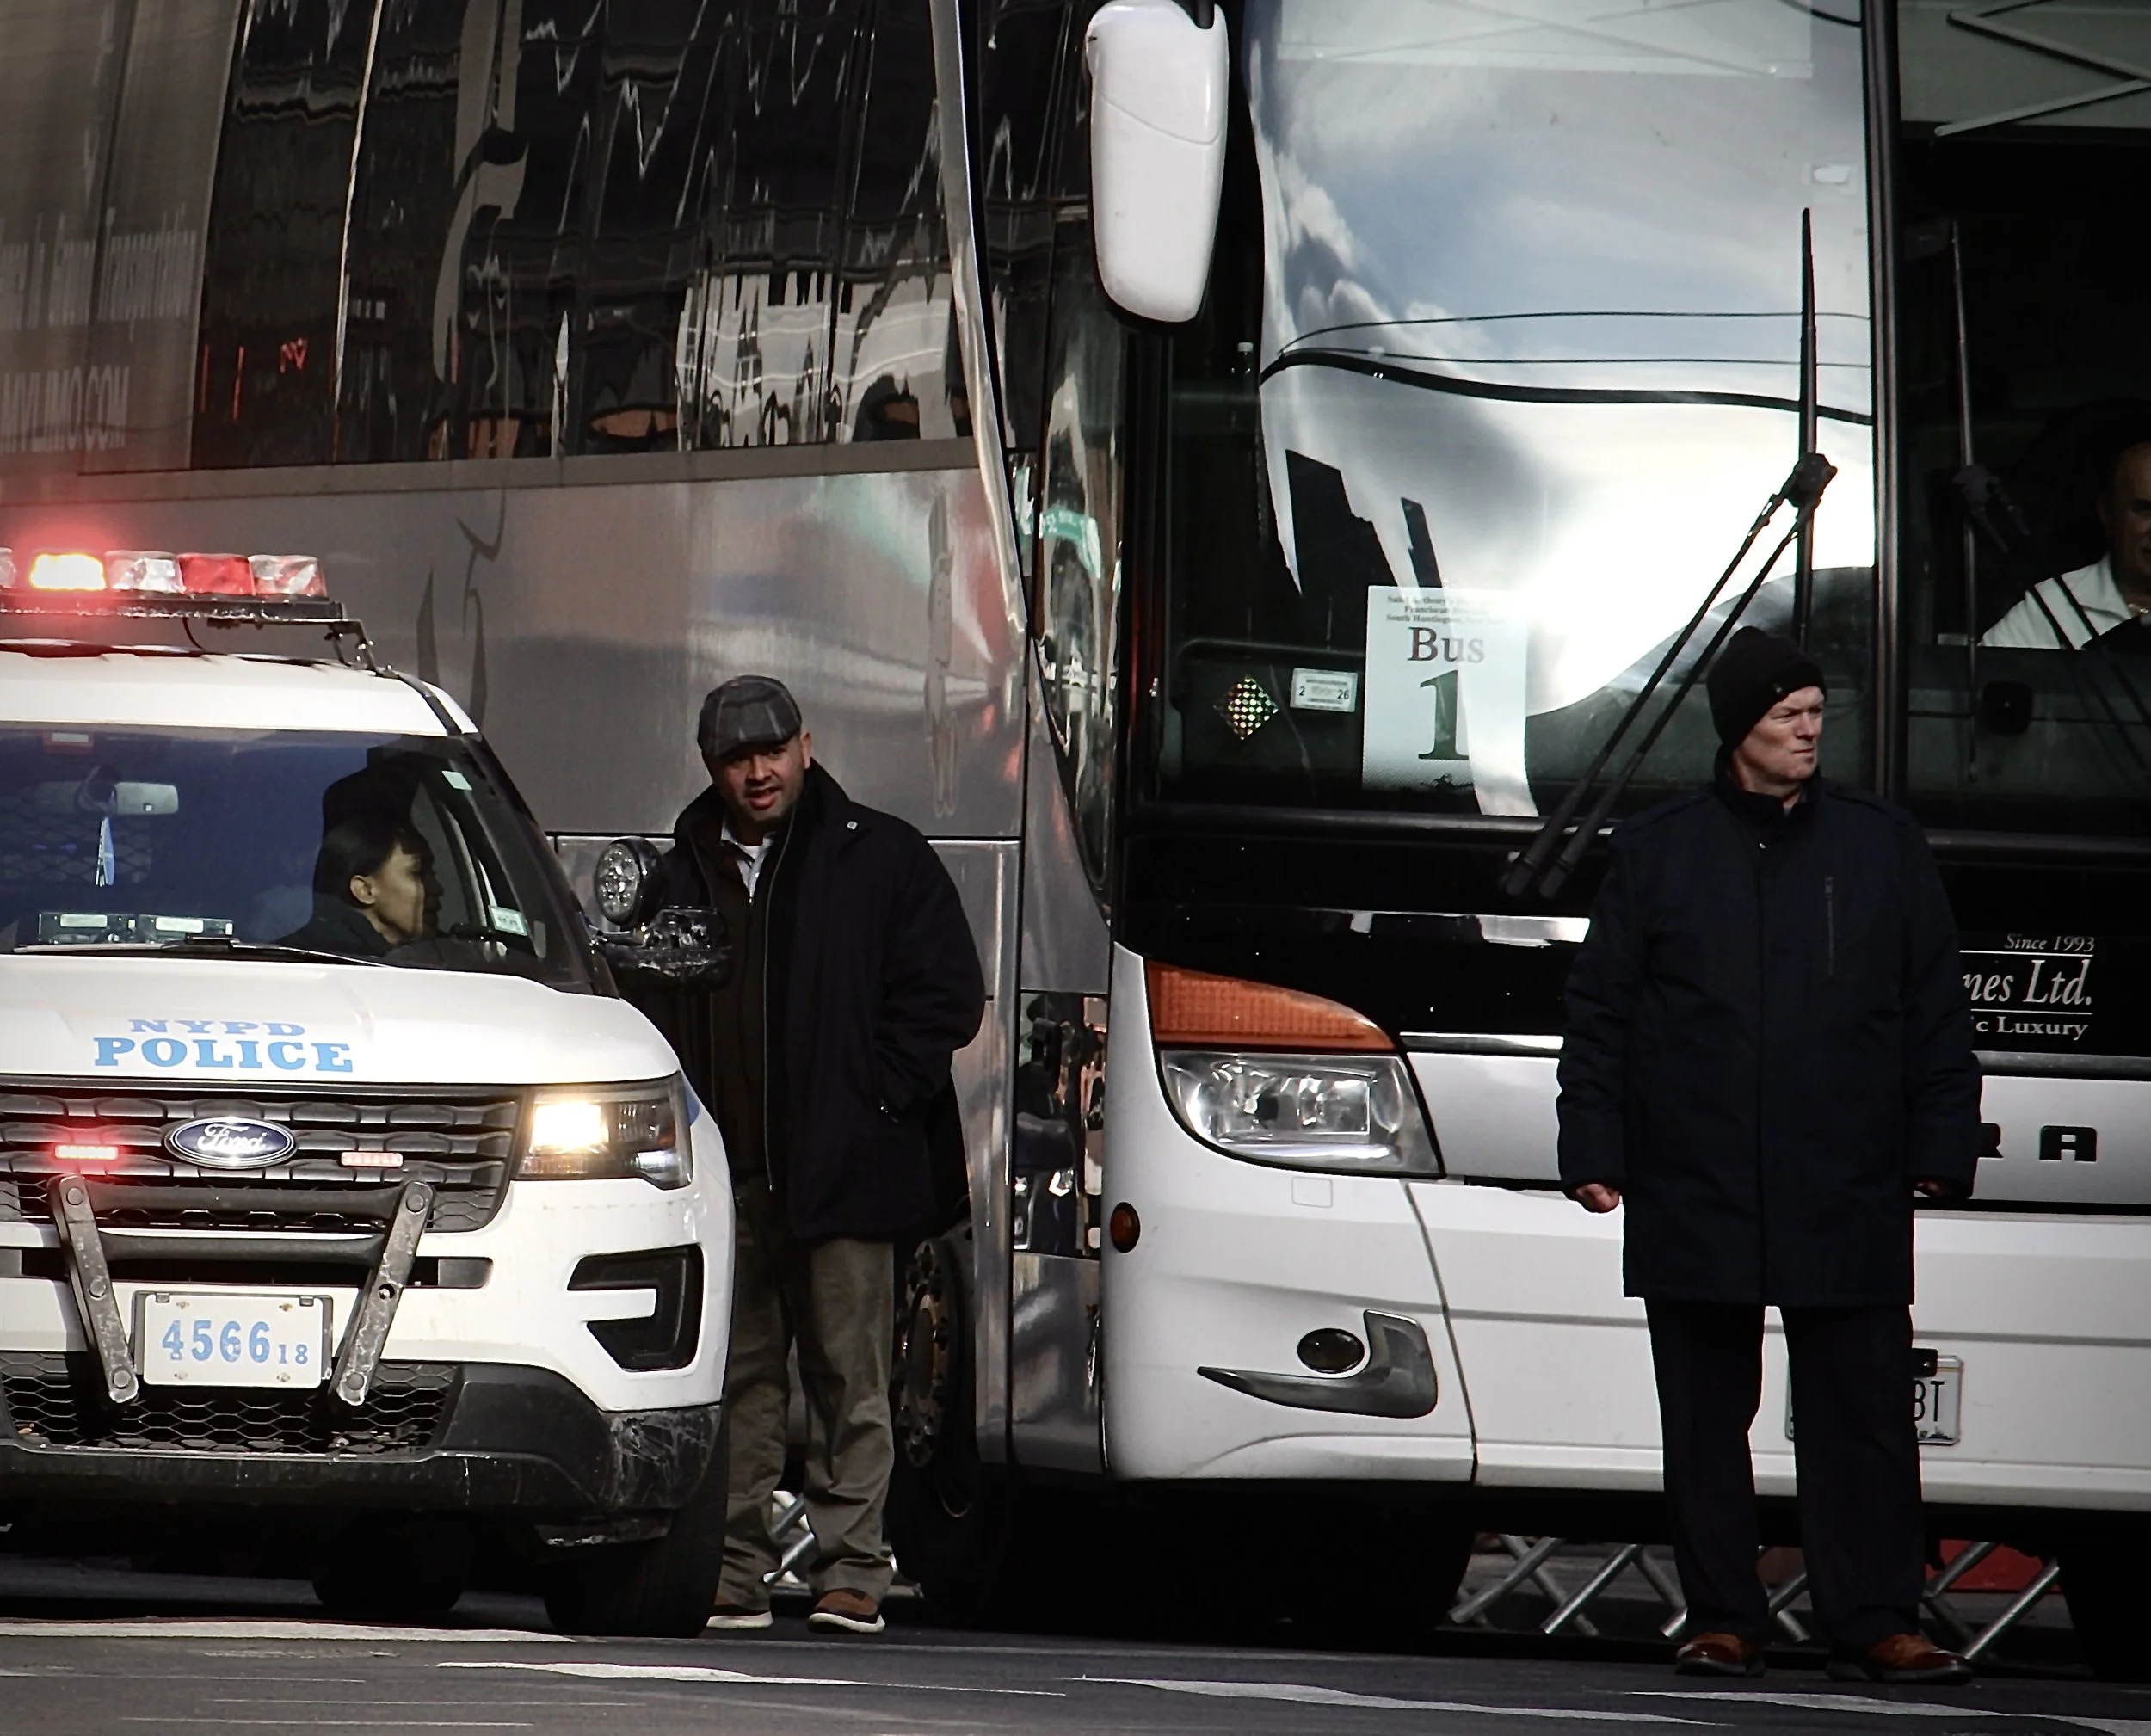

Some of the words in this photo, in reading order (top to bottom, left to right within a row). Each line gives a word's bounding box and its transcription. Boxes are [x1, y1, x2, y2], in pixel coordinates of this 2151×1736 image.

[1407, 626, 1484, 664] Bus
[1418, 669, 1470, 761] 1
[2004, 933, 2048, 950] Since
[2054, 935, 2096, 952] 1993
[2022, 958, 2092, 1006] Ltd.
[129, 1019, 305, 1037] NYPD
[1996, 1015, 2088, 1041] Luxury
[93, 1037, 354, 1073] POLICE
[197, 1123, 268, 1154] Ford
[162, 1320, 271, 1364] 4566
[279, 1344, 309, 1365] 18
